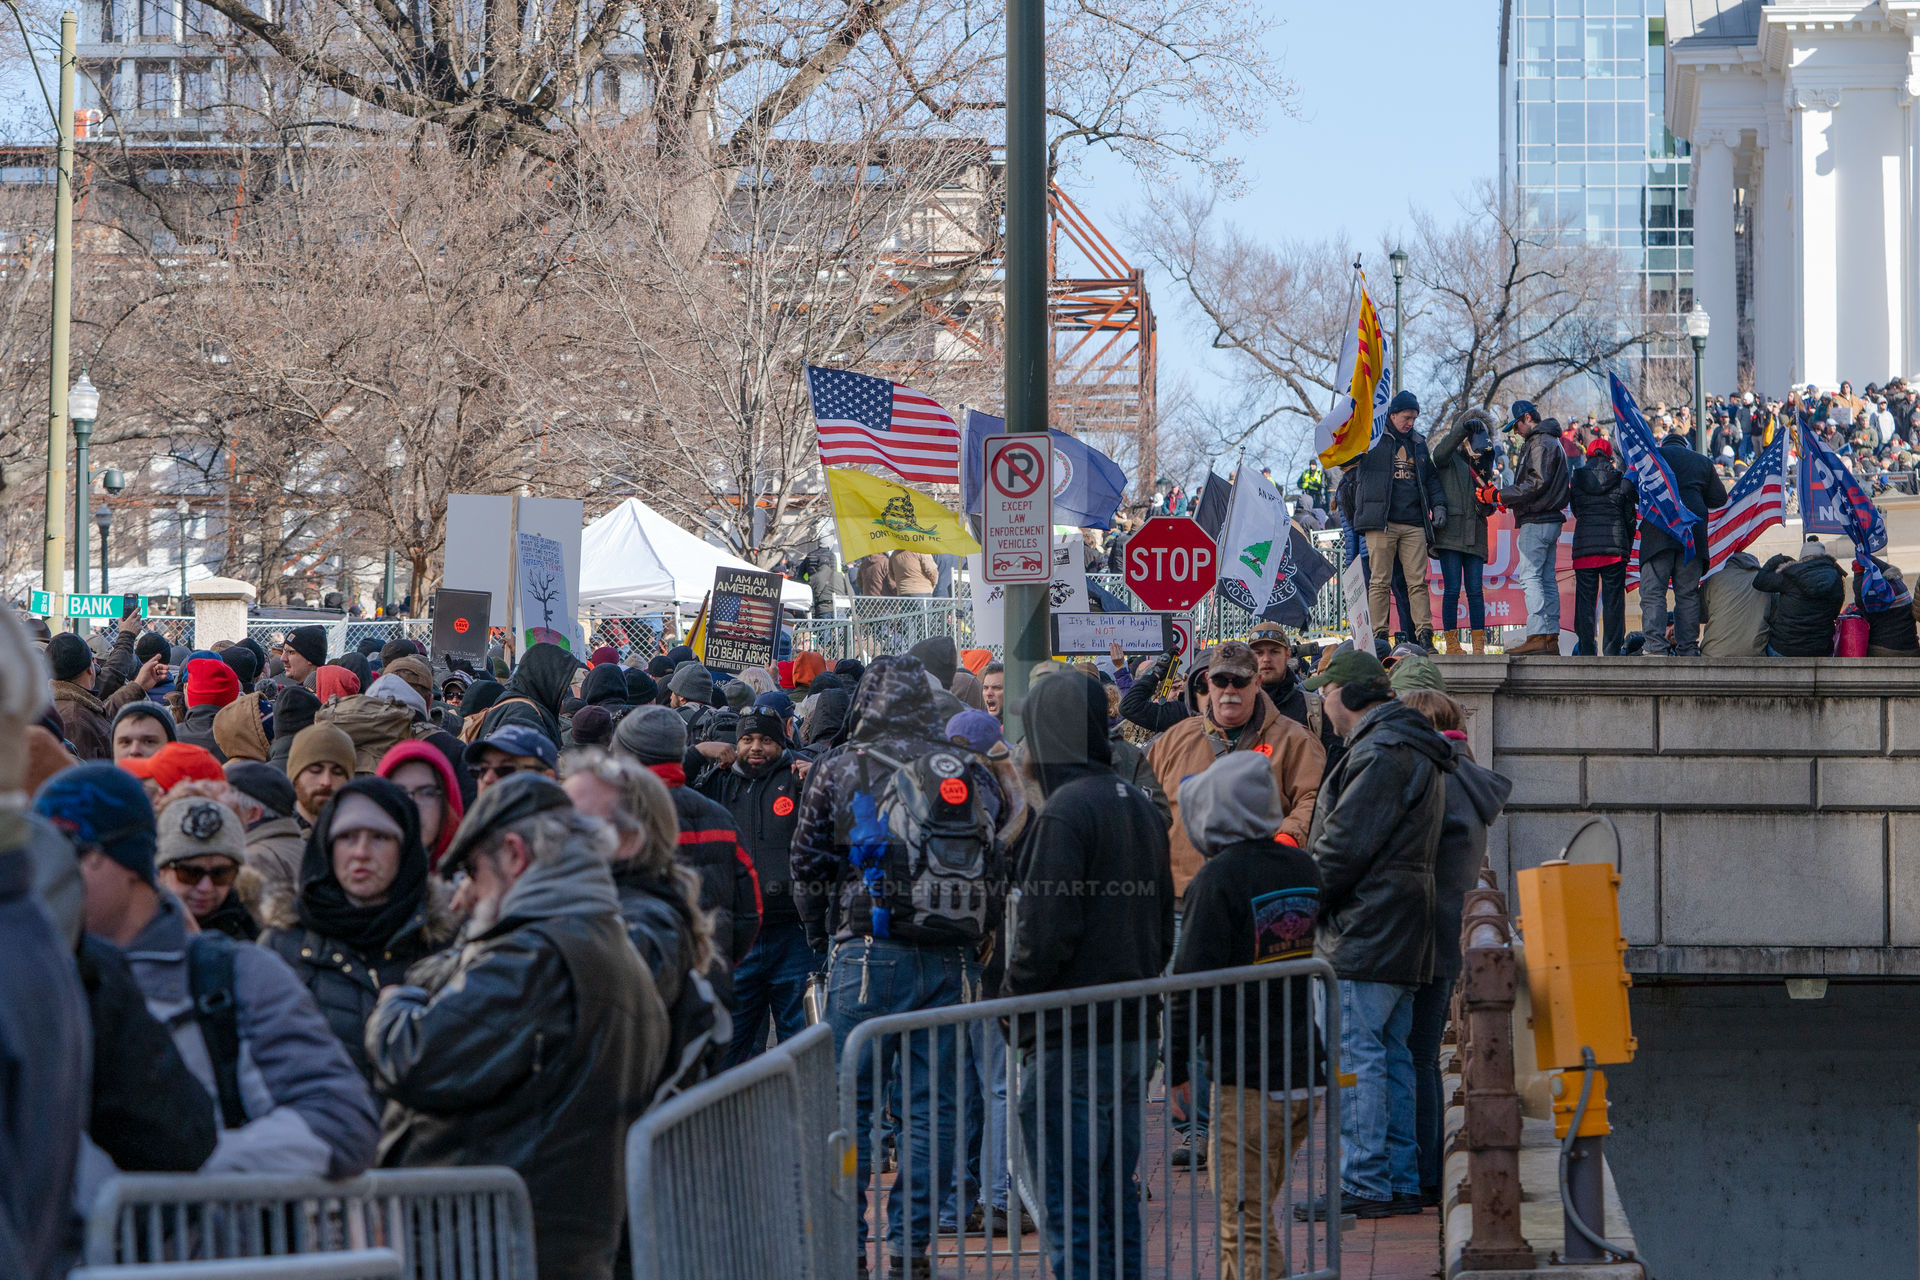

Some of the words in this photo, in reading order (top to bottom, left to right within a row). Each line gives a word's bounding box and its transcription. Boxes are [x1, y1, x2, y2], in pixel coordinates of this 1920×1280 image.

[1001, 500, 1033, 511] EXCEPT
[1008, 513, 1026, 524] LAW
[989, 525, 1045, 537] ENFORCEMENT
[912, 534, 925, 542] ON
[997, 538, 1038, 549] VEHICLES
[1130, 547, 1211, 582] STOP
[729, 573, 734, 582] I
[735, 574, 751, 584] AM
[752, 577, 767, 586] AN
[715, 581, 779, 598] AMERICAN
[1226, 581, 1241, 597] GO
[1242, 593, 1258, 608] ON
[70, 597, 113, 615] BANK
[1086, 616, 1096, 625] the
[1100, 616, 1114, 625] Bill
[1117, 616, 1126, 625] of
[1130, 616, 1158, 631] Rights
[1095, 627, 1116, 635] NOT
[712, 637, 732, 647] HAVE
[734, 641, 748, 650] THE
[749, 643, 771, 652] RIGHT
[1072, 639, 1085, 649] the
[707, 644, 720, 658] TO
[720, 646, 743, 661] BEAR
[744, 649, 770, 664] ARMS
